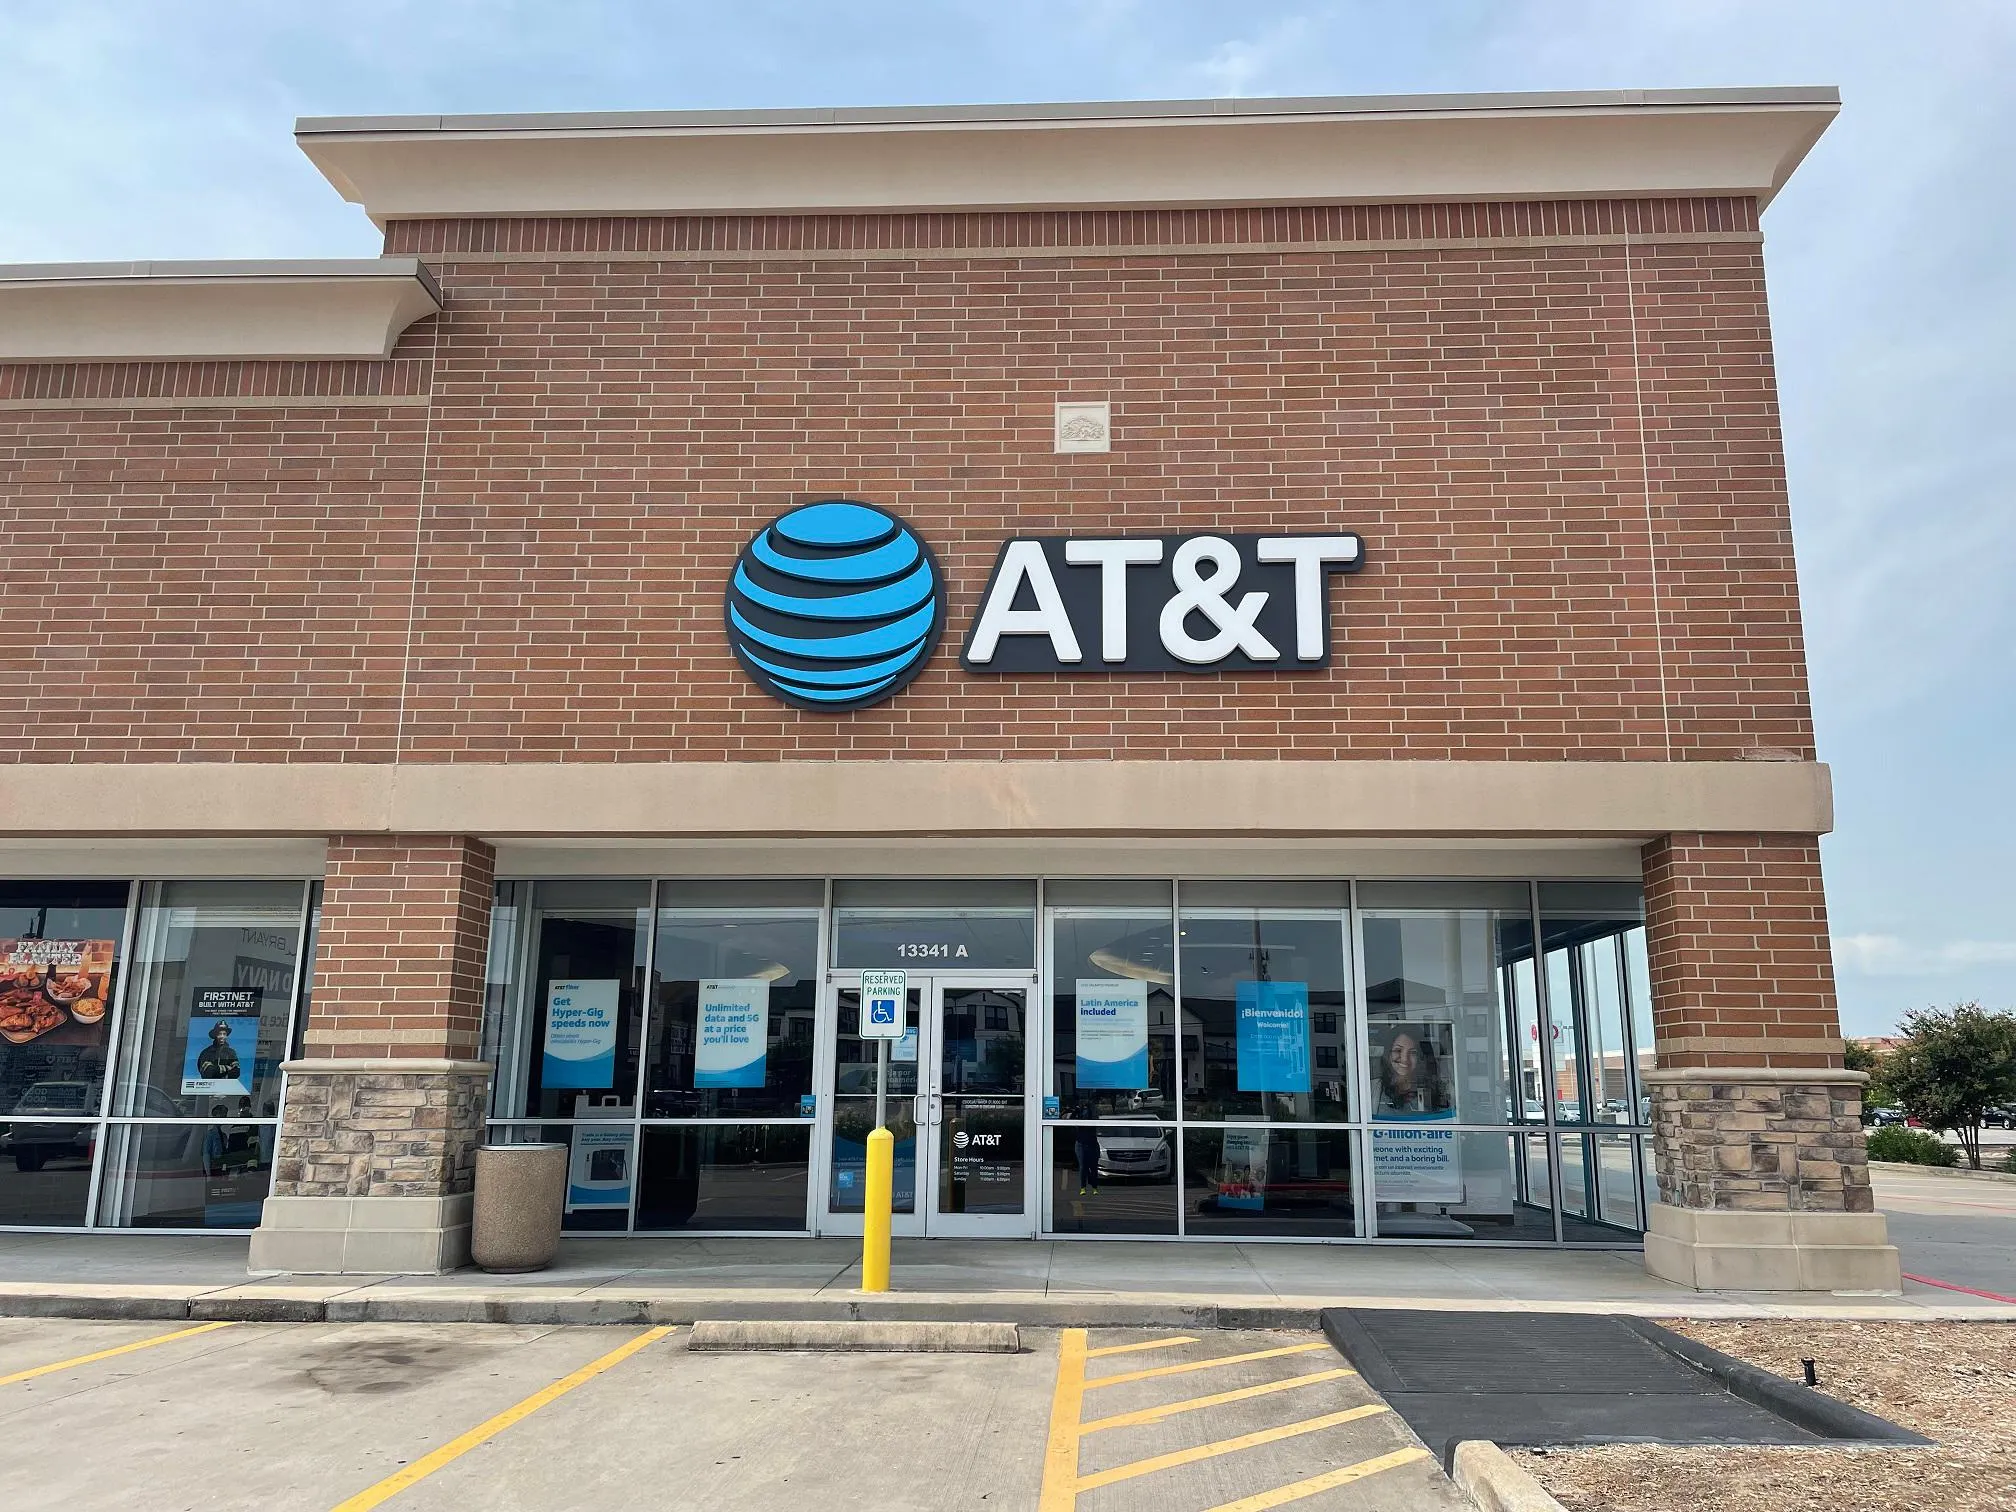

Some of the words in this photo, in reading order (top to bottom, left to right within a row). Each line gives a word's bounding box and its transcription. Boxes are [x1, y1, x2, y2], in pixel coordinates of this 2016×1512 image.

[967, 536, 1358, 663] AT&T
[897, 944, 949, 958] 13341
[955, 944, 969, 958] A
[864, 975, 904, 984] RESERVED
[203, 991, 253, 1001] FIRSTNET
[866, 987, 901, 996] PARKING
[552, 997, 571, 1006] Get
[1080, 999, 1102, 1007] Latin
[1103, 999, 1139, 1007] America
[705, 1003, 751, 1012] Unlimited
[1080, 1007, 1117, 1016] included
[551, 1007, 604, 1019] Hyper-Gig
[704, 1013, 726, 1023] data
[727, 1013, 746, 1023] and
[746, 1014, 760, 1023] 5G
[1241, 1007, 1304, 1019] ¡Bienvenido!
[551, 1019, 587, 1029] speeds
[588, 1020, 610, 1028] now
[704, 1024, 715, 1033] at
[723, 1024, 747, 1035] price
[703, 1035, 729, 1046] you'll
[730, 1035, 750, 1044] love
[971, 1134, 1002, 1146] AT&T
[1395, 1145, 1412, 1153] with
[1413, 1145, 1443, 1154] exciting
[1390, 1154, 1404, 1162] and
[1411, 1154, 1436, 1164] boring
[1436, 1154, 1450, 1162] bill.
